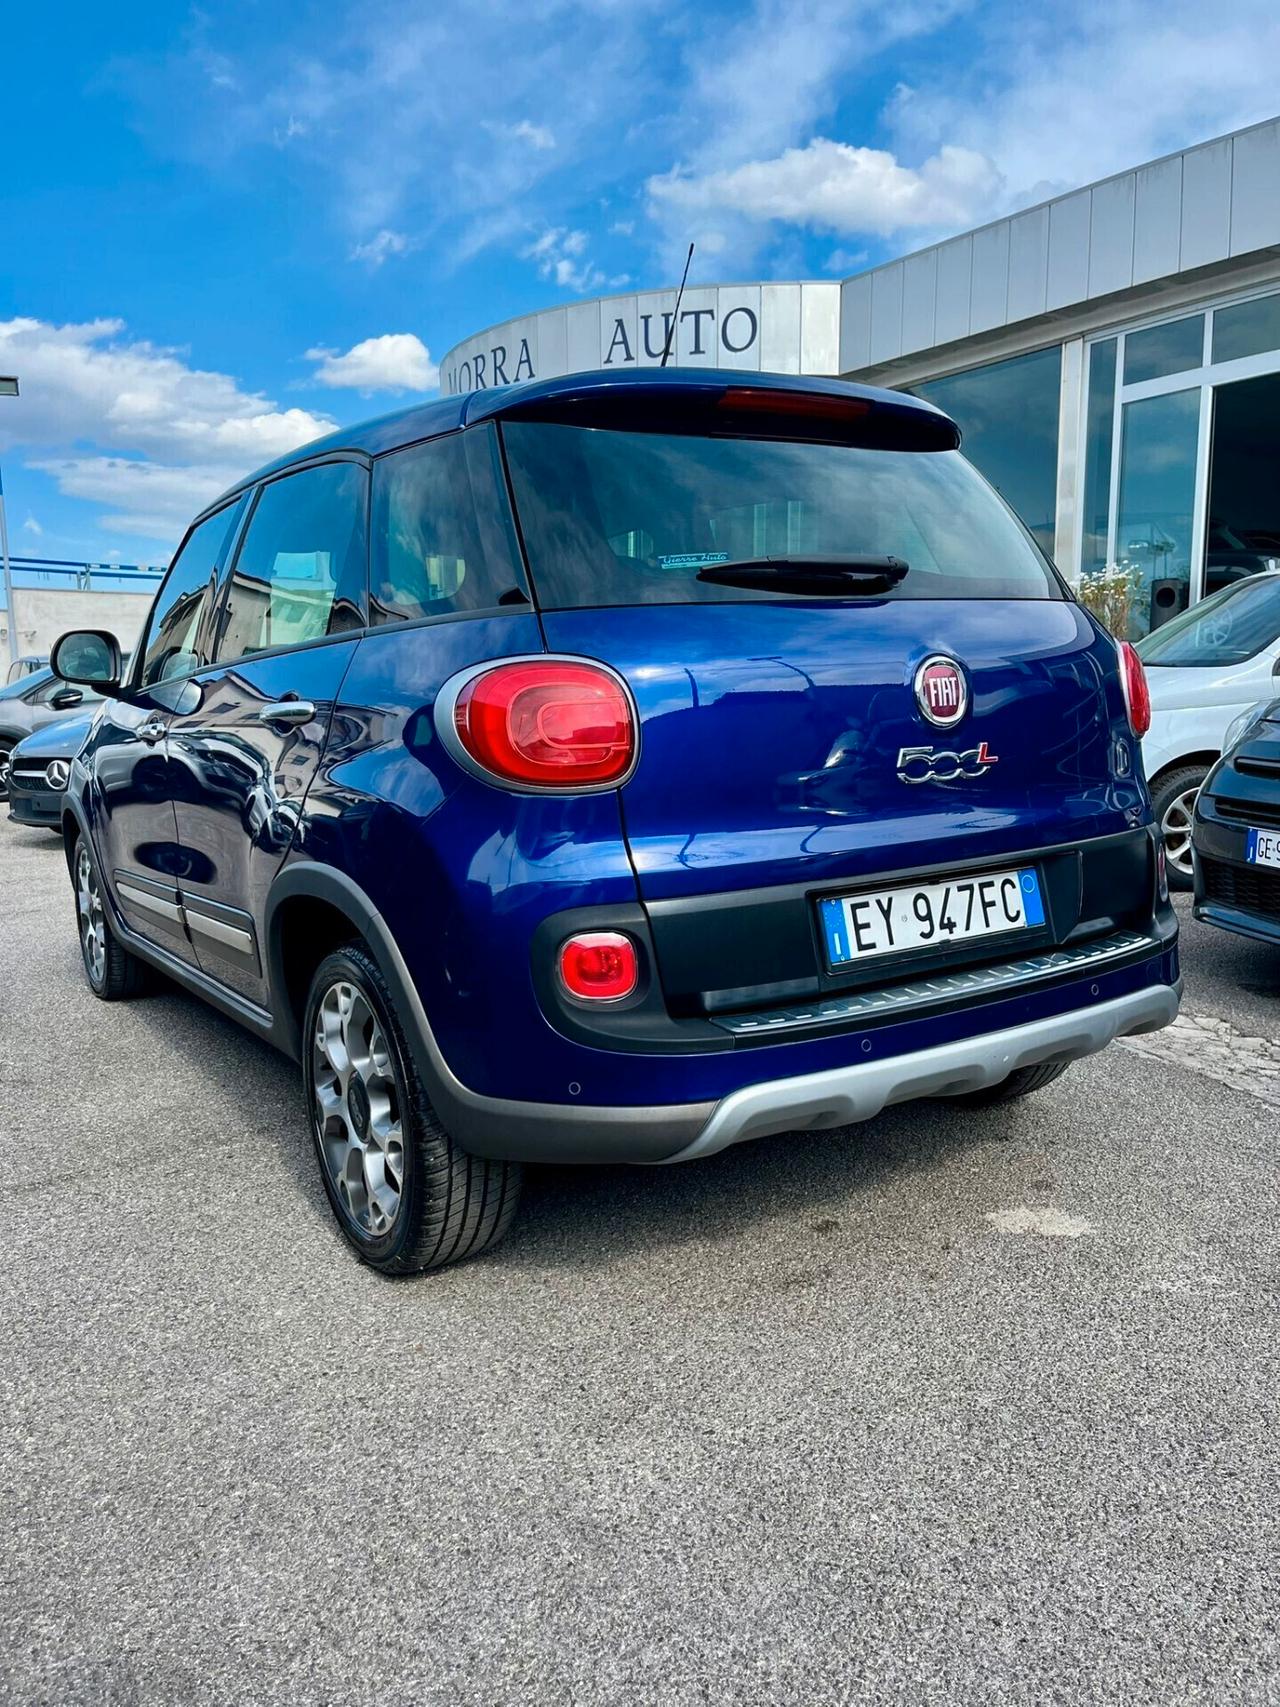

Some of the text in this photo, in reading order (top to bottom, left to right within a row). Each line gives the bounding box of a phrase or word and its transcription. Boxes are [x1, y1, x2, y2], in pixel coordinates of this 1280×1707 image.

[448, 307, 758, 395] MORRA AUTO
[928, 676, 957, 708] FIAT
[850, 878, 1021, 952] EY 947FC
